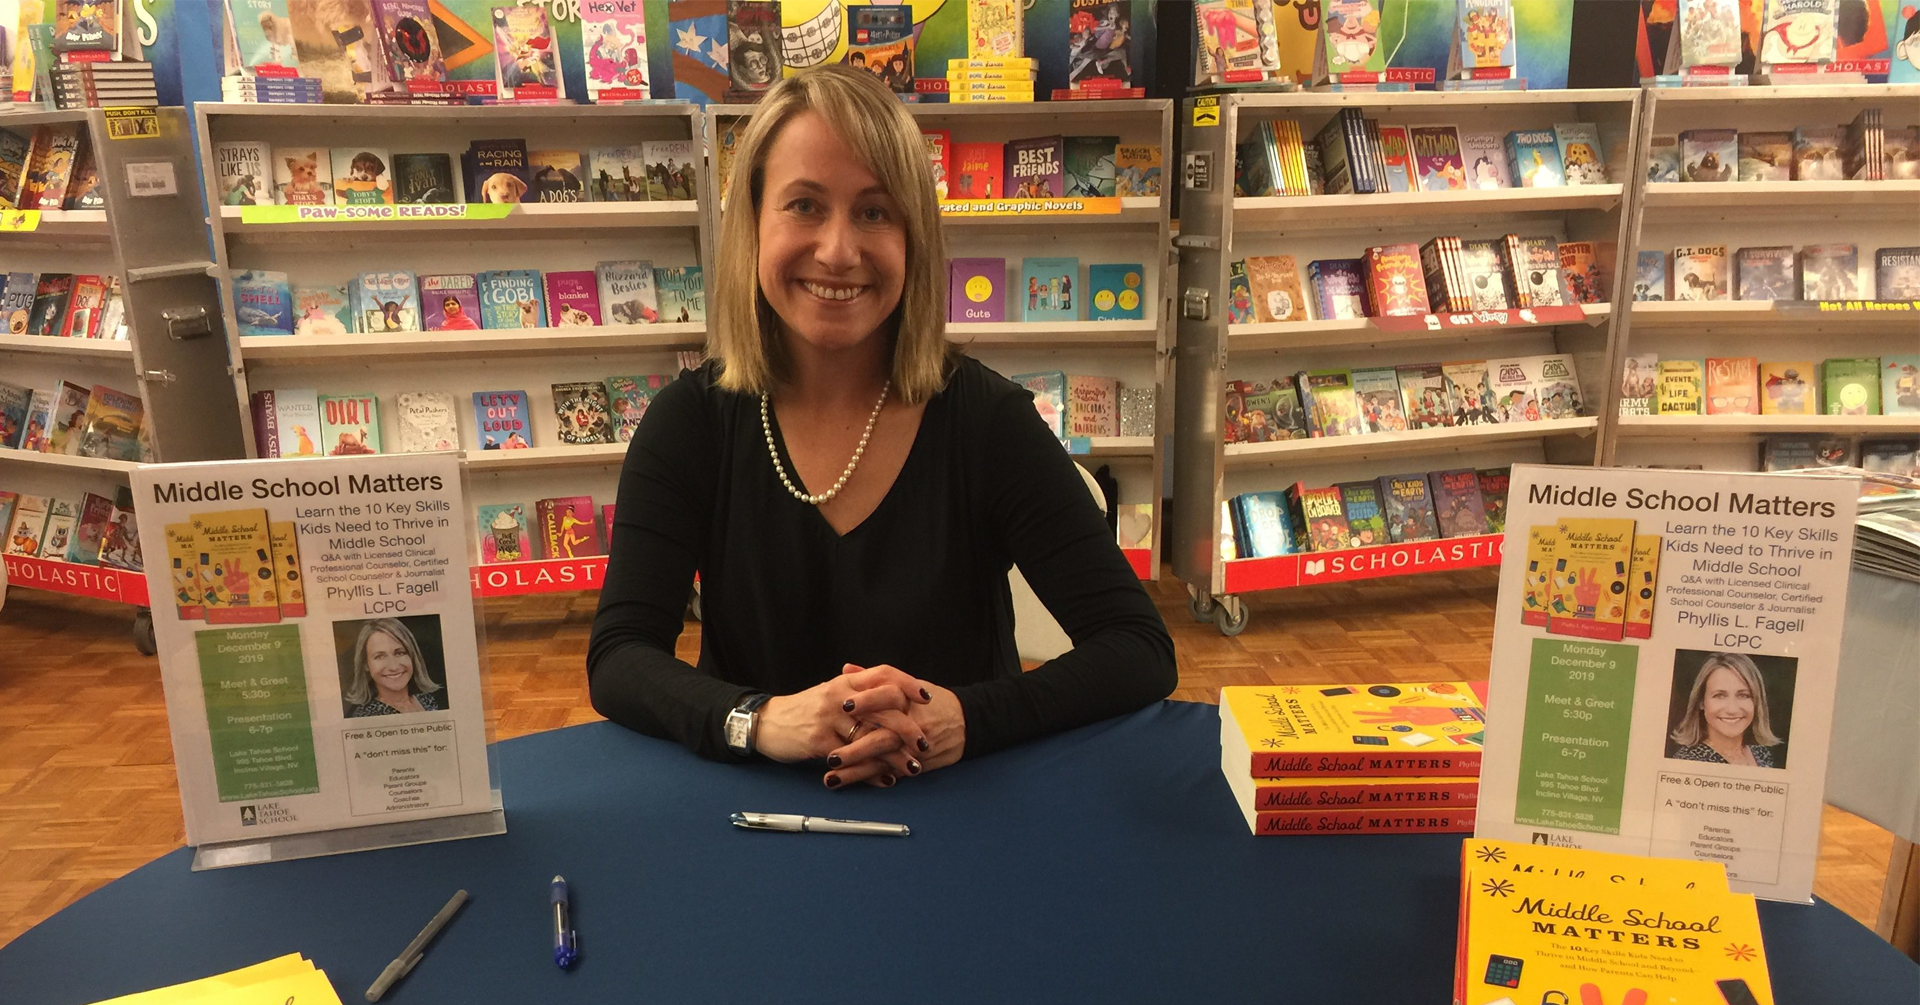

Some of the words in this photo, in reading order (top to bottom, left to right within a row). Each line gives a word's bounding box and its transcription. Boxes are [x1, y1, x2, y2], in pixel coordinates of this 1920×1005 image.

[588, 1, 614, 13] Hex
[618, 0, 636, 13] Vet
[1414, 134, 1458, 157] CATWAD
[220, 148, 260, 162] STRAYS
[478, 150, 522, 159] RACING
[1018, 148, 1054, 166] BEST
[221, 162, 243, 178] LIKE
[246, 162, 262, 177] US
[494, 159, 522, 167] RAIN
[400, 205, 466, 216] READS!
[972, 202, 993, 212] and
[996, 201, 1042, 214] Graphic
[1044, 200, 1084, 211] Novels
[1698, 248, 1724, 256] DOGS
[426, 278, 440, 288] she
[440, 276, 472, 288] DARED
[606, 270, 648, 282] Blizzard
[654, 268, 682, 283] FROM
[491, 278, 534, 289] FINDING
[611, 281, 648, 295] Besties
[682, 277, 702, 291] YOU
[6, 292, 34, 308] PUG
[492, 289, 534, 304] GOBI
[558, 292, 590, 300] blanket
[687, 298, 702, 310] ME
[1820, 302, 1842, 312] Not
[1844, 302, 1862, 312] All
[966, 308, 990, 318] Guts
[1450, 314, 1474, 324] GET
[481, 394, 520, 407] LETY
[1670, 389, 1688, 398] LIFE
[264, 392, 276, 429] BYARS
[278, 404, 312, 412] WANTED
[325, 398, 372, 426] DIRT
[410, 406, 424, 414] Petal
[426, 406, 449, 414] Pushers
[486, 406, 518, 419] OUT
[558, 402, 571, 416] WITH
[570, 396, 582, 404] THE
[584, 397, 604, 413] MIGHT
[1662, 402, 1696, 412] CACTUS
[484, 418, 523, 432] LOUD
[566, 434, 576, 442] OF
[576, 432, 601, 443] ANGELS
[153, 480, 243, 504] Middle
[252, 476, 340, 499] School
[348, 474, 443, 495] Matters
[1400, 487, 1424, 497] EARTH
[1528, 484, 1617, 508] Middle
[1626, 488, 1719, 513] School
[1729, 493, 1836, 518] Matters
[296, 506, 334, 518] Learn
[339, 504, 360, 516] the
[366, 503, 381, 516] 10
[386, 502, 412, 516] Key
[416, 500, 450, 512] Skills
[300, 522, 331, 535] Kids
[336, 520, 370, 533] Need
[376, 520, 389, 532] to
[393, 517, 433, 530] Thrive
[438, 516, 449, 528] in
[1666, 521, 1707, 536] Learn
[1712, 523, 1736, 537] the
[1742, 524, 1759, 538] 10
[1764, 526, 1793, 543] Key
[1798, 528, 1838, 542] Skills
[329, 536, 376, 550] Middle
[379, 534, 426, 548] School
[546, 513, 560, 558] CALLBACK
[1665, 539, 1699, 553] Kids
[1704, 541, 1742, 556] Need
[1748, 545, 1763, 557] to
[1768, 544, 1814, 559] Thrive
[1820, 548, 1832, 561] in
[311, 564, 363, 573] Professional
[366, 561, 411, 570] Counselor,
[413, 558, 449, 567] Certified
[1692, 559, 1743, 574] Middle
[1748, 562, 1802, 577] School
[317, 574, 347, 583] School
[350, 572, 393, 581] Counselor
[405, 569, 445, 578] Journalist
[1680, 575, 1702, 584] Q&A
[1705, 577, 1724, 585] with
[1728, 578, 1771, 588] Licensed
[1774, 581, 1810, 591] Clinical
[327, 585, 373, 600] Phyllis
[378, 584, 391, 595] L.
[397, 581, 439, 596] Fagell
[1666, 586, 1724, 597] Professional
[1781, 592, 1824, 603] Certified
[364, 600, 406, 614] LCPC
[1670, 597, 1703, 607] School
[1706, 599, 1755, 610] Counselor
[1758, 603, 1764, 611] &
[1768, 604, 1816, 614] Journalist
[1678, 611, 1729, 629] Phyllis
[1735, 615, 1748, 628] L.
[1756, 616, 1804, 634] Fagell
[1714, 633, 1762, 649] LCPC
[1563, 644, 1607, 658] Monday
[1551, 656, 1606, 669] December
[1609, 661, 1616, 669] 9
[1569, 671, 1595, 681] 2019
[1544, 695, 1571, 705] Meet
[1574, 697, 1582, 706] &
[1585, 698, 1615, 709] Greet
[1563, 709, 1592, 721] 5:30p
[1542, 733, 1609, 747] Presentation
[1561, 748, 1586, 760] 6-7p
[1264, 757, 1313, 772] Middle
[1317, 757, 1364, 771] School
[1369, 759, 1452, 768] MATTERS
[1660, 775, 1681, 785] Free
[1684, 777, 1691, 786] &
[1694, 778, 1720, 788] Open
[1723, 782, 1732, 790] to
[1735, 783, 1751, 792] the
[1754, 784, 1784, 795] Public
[1264, 792, 1313, 806] Middle
[1317, 790, 1364, 805] School
[1369, 792, 1450, 802] MATTERS
[1264, 817, 1313, 831] Middle
[1317, 816, 1364, 831] School
[1368, 818, 1449, 827] MATTERS
[1512, 897, 1613, 924] Middle
[1622, 909, 1721, 933] School
[1532, 921, 1700, 950] MATTERS
[1550, 943, 1567, 951] The
[1584, 946, 1599, 956] Key
[1601, 949, 1625, 957] Skills
[1628, 951, 1648, 959] Kids
[1650, 954, 1673, 962] Need
